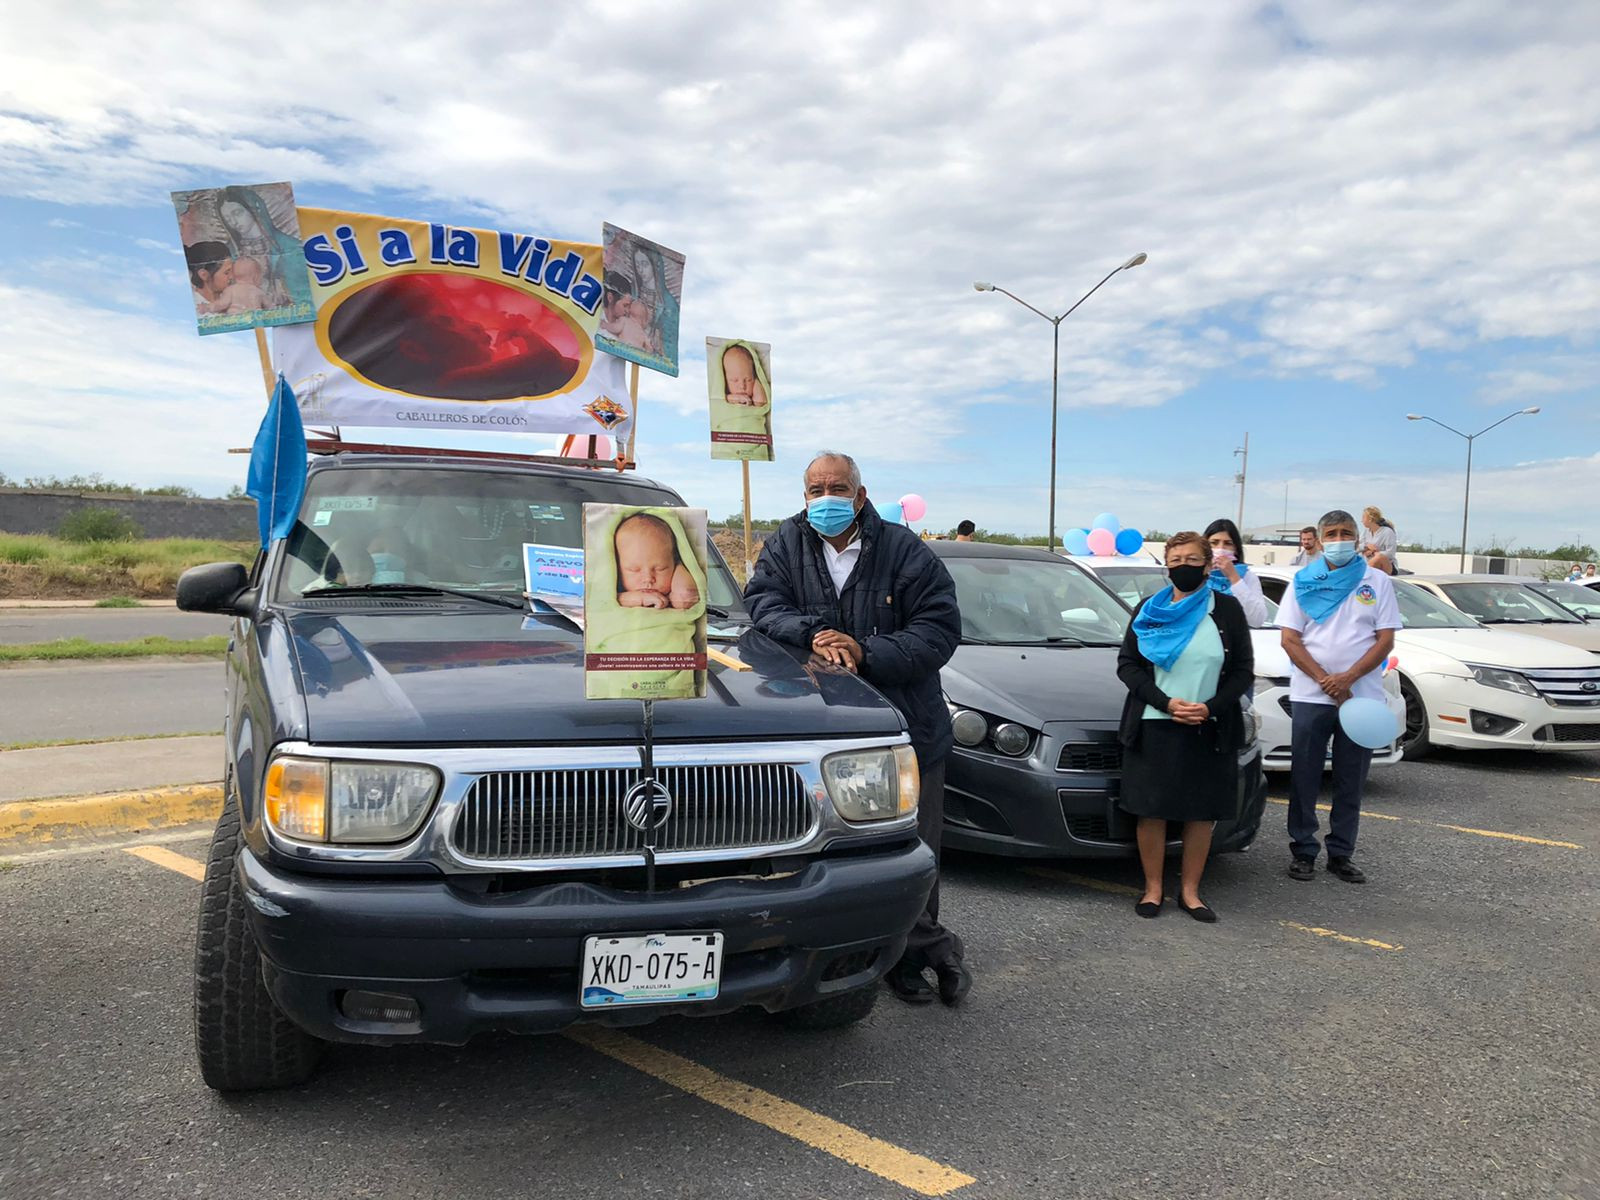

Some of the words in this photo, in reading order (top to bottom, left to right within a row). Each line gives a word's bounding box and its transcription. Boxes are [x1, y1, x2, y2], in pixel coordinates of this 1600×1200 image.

[303, 225, 368, 286] Si
[379, 229, 417, 267] a
[429, 223, 480, 269] la
[498, 231, 603, 316] Vida
[396, 411, 469, 424] CABALLEROS
[471, 414, 487, 424] DE
[489, 415, 528, 426] COLÓN
[590, 951, 715, 985] XKD-075-A
